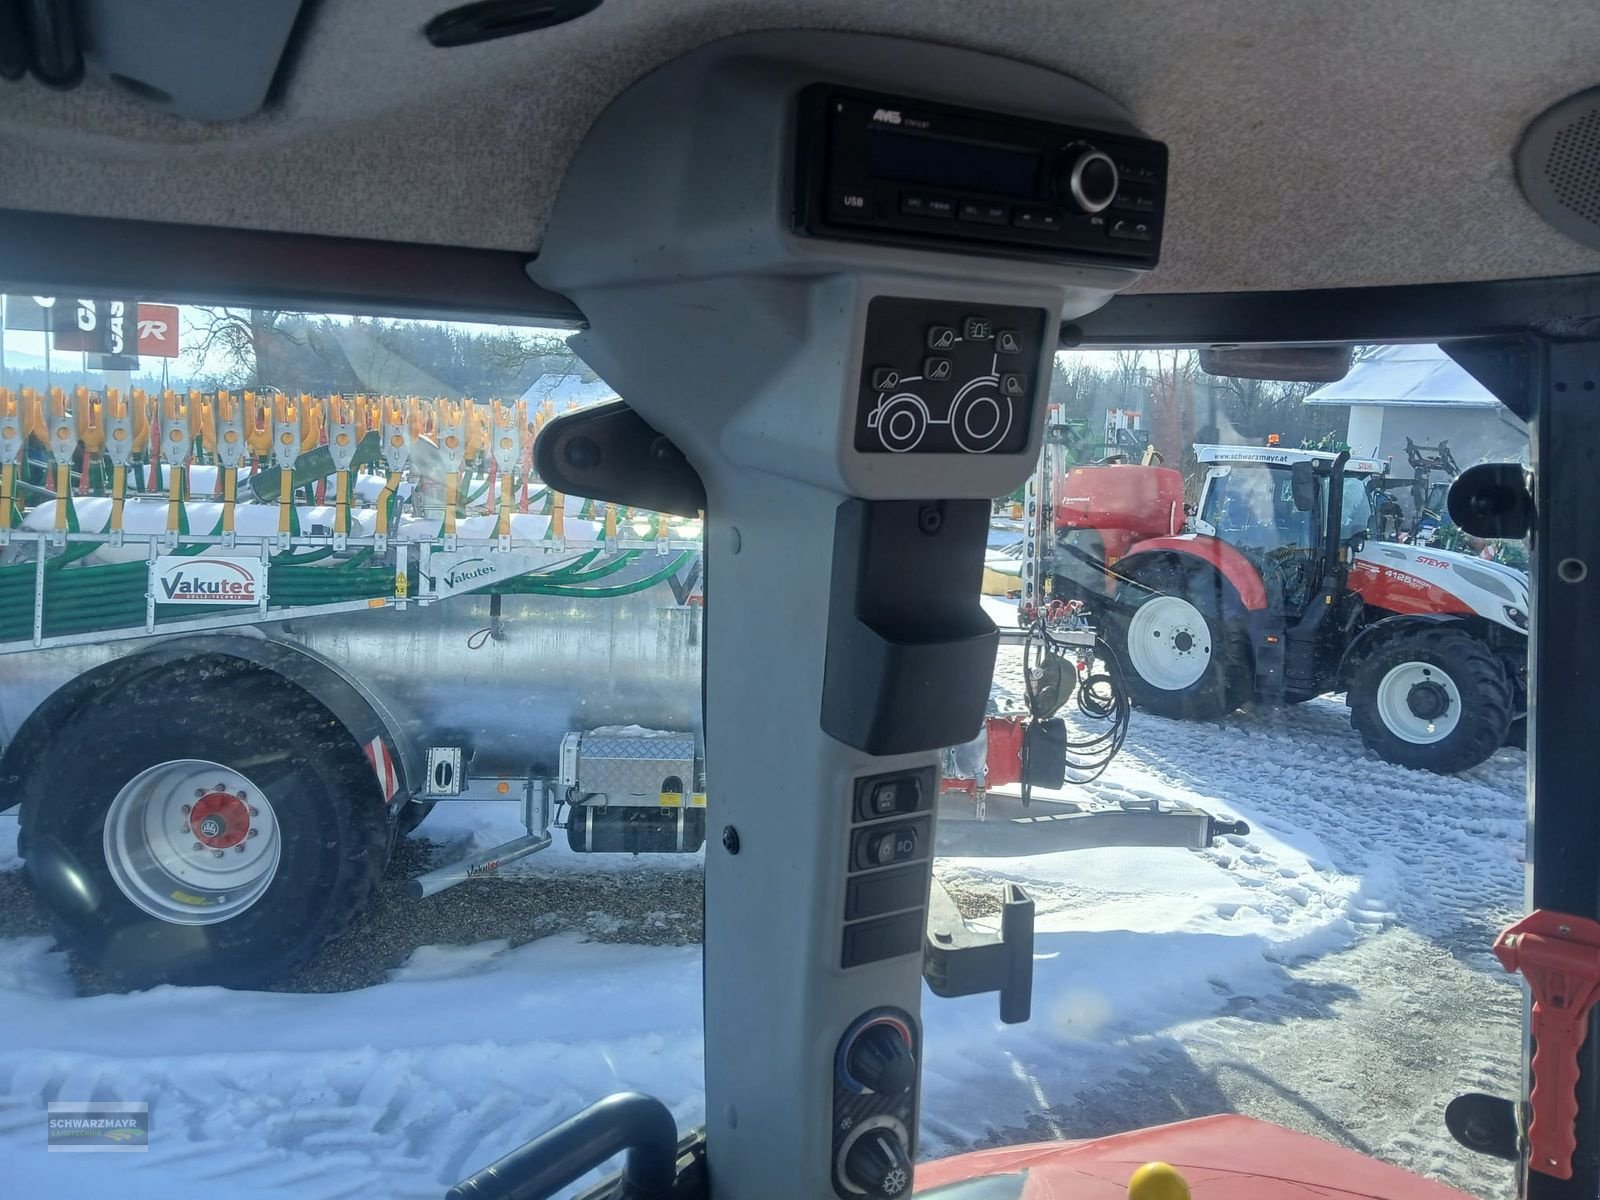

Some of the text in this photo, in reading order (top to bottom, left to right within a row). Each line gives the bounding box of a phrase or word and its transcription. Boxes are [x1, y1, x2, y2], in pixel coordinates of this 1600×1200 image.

[872, 108, 902, 124] AMS
[843, 195, 864, 208] USB
[1214, 453, 1288, 463] www.schwarzmayr.at
[1416, 556, 1450, 570] STEYR
[443, 566, 497, 589] Vakutec
[1385, 565, 1412, 584] 4125
[160, 571, 255, 599] Vakutec
[466, 859, 500, 877] Vakutec
